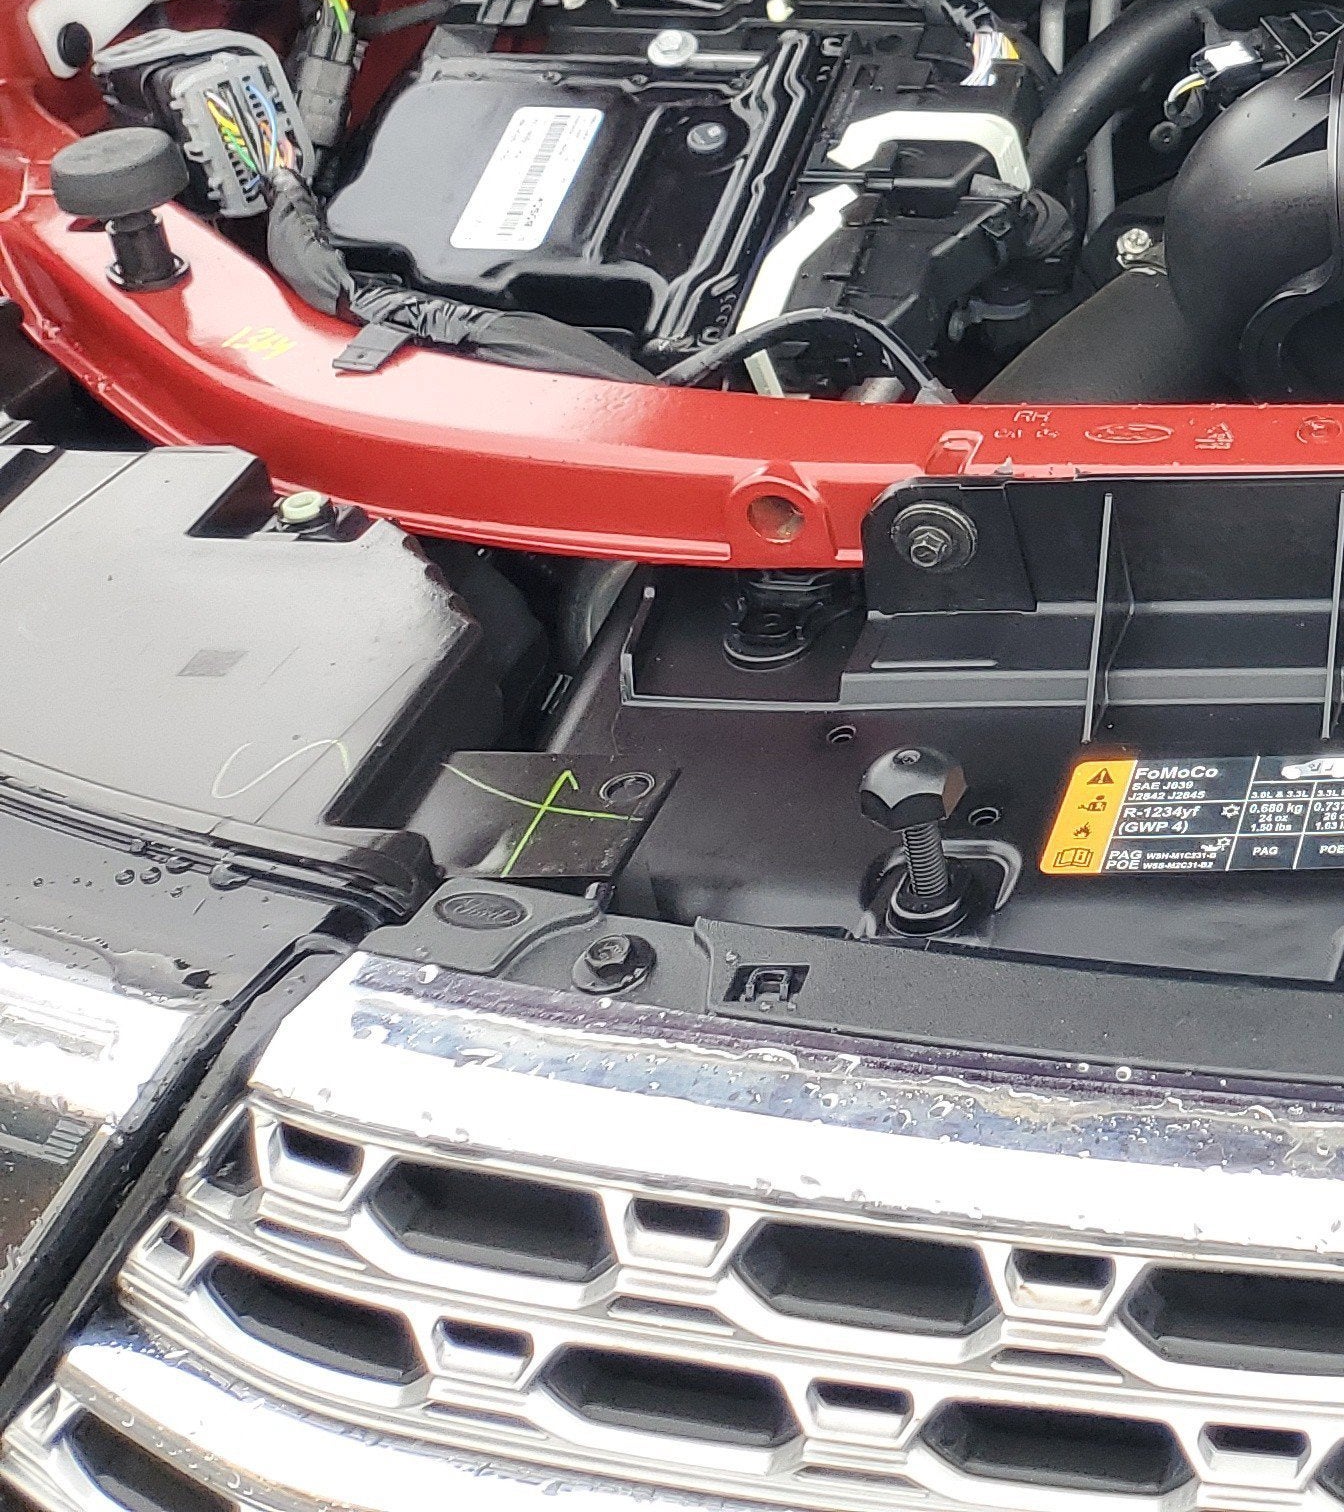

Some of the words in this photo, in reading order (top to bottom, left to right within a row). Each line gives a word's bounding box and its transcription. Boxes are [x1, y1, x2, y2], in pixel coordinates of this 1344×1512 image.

[1134, 766, 1220, 780] FoMoCo
[1132, 782, 1160, 790] SAE
[1317, 789, 1340, 797] 3.3L
[1124, 806, 1201, 819] R-1234yf
[1250, 804, 1284, 814] 0.680
[1287, 803, 1304, 814] kg
[1259, 814, 1272, 822] 24
[1118, 822, 1168, 834] (GWP
[1171, 821, 1188, 834] 4)
[1275, 823, 1292, 831] lbs
[1108, 850, 1142, 860] PAG
[1252, 846, 1279, 856] PAG
[1105, 860, 1140, 870] POE
